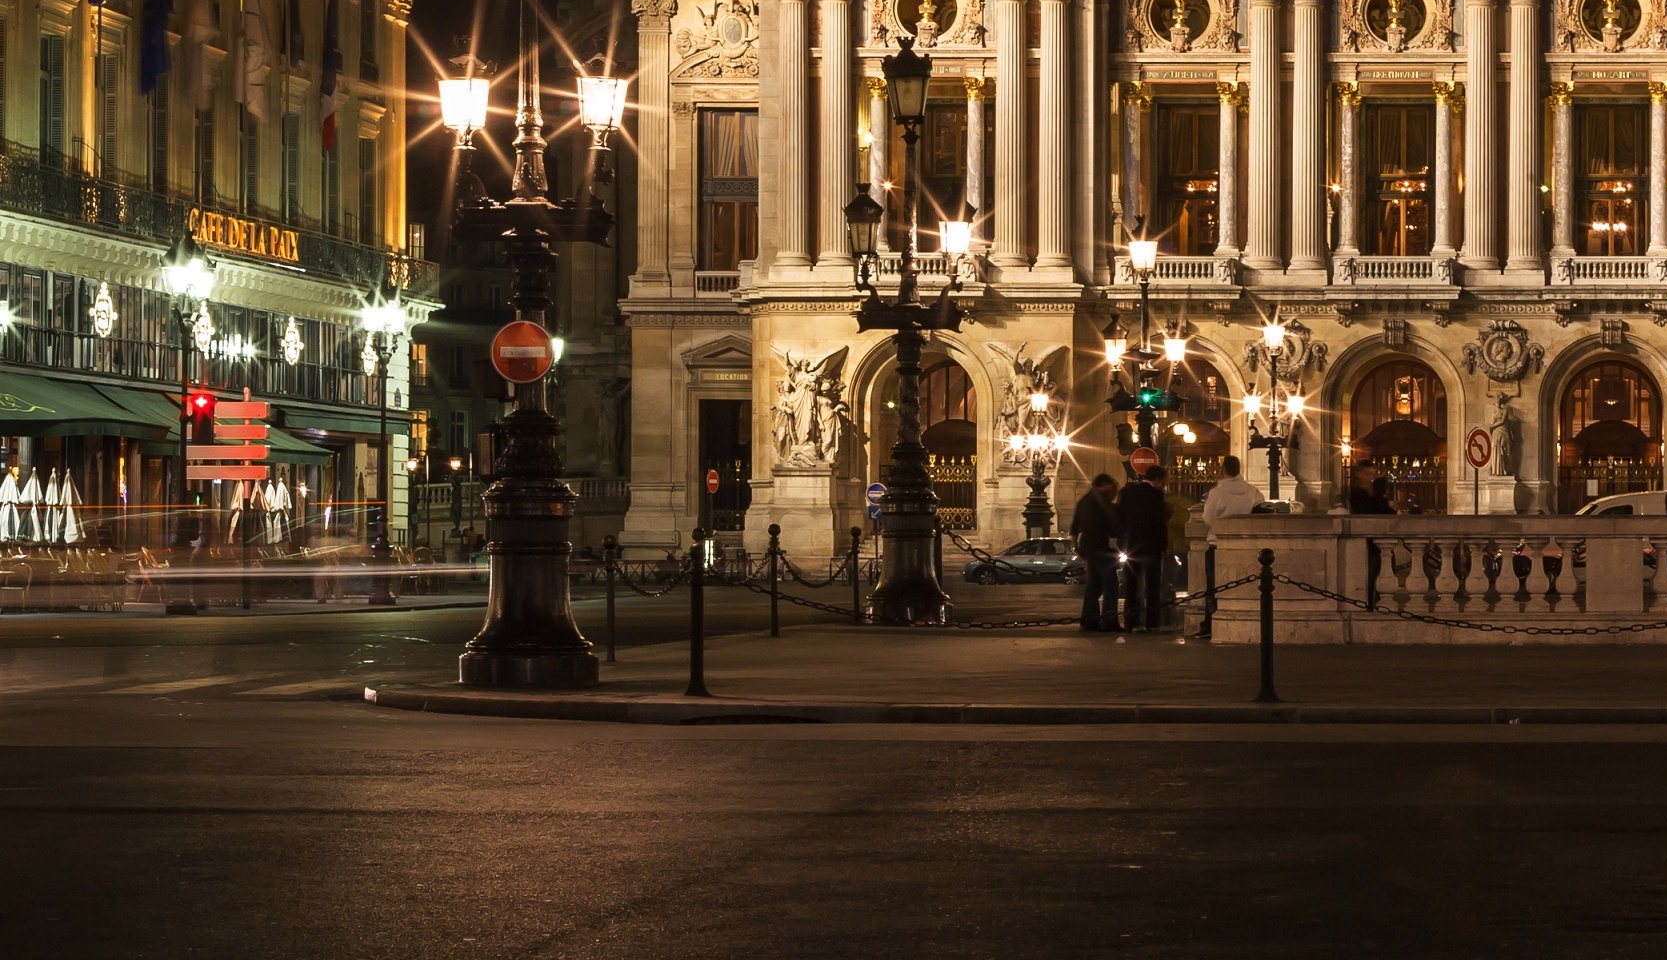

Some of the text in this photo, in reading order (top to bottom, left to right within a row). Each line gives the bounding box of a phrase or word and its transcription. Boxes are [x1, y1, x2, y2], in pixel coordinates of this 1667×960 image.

[1163, 71, 1197, 79] AUBER
[1592, 71, 1632, 79] MOZART
[188, 207, 299, 262] CAFE DE LA PAIX
